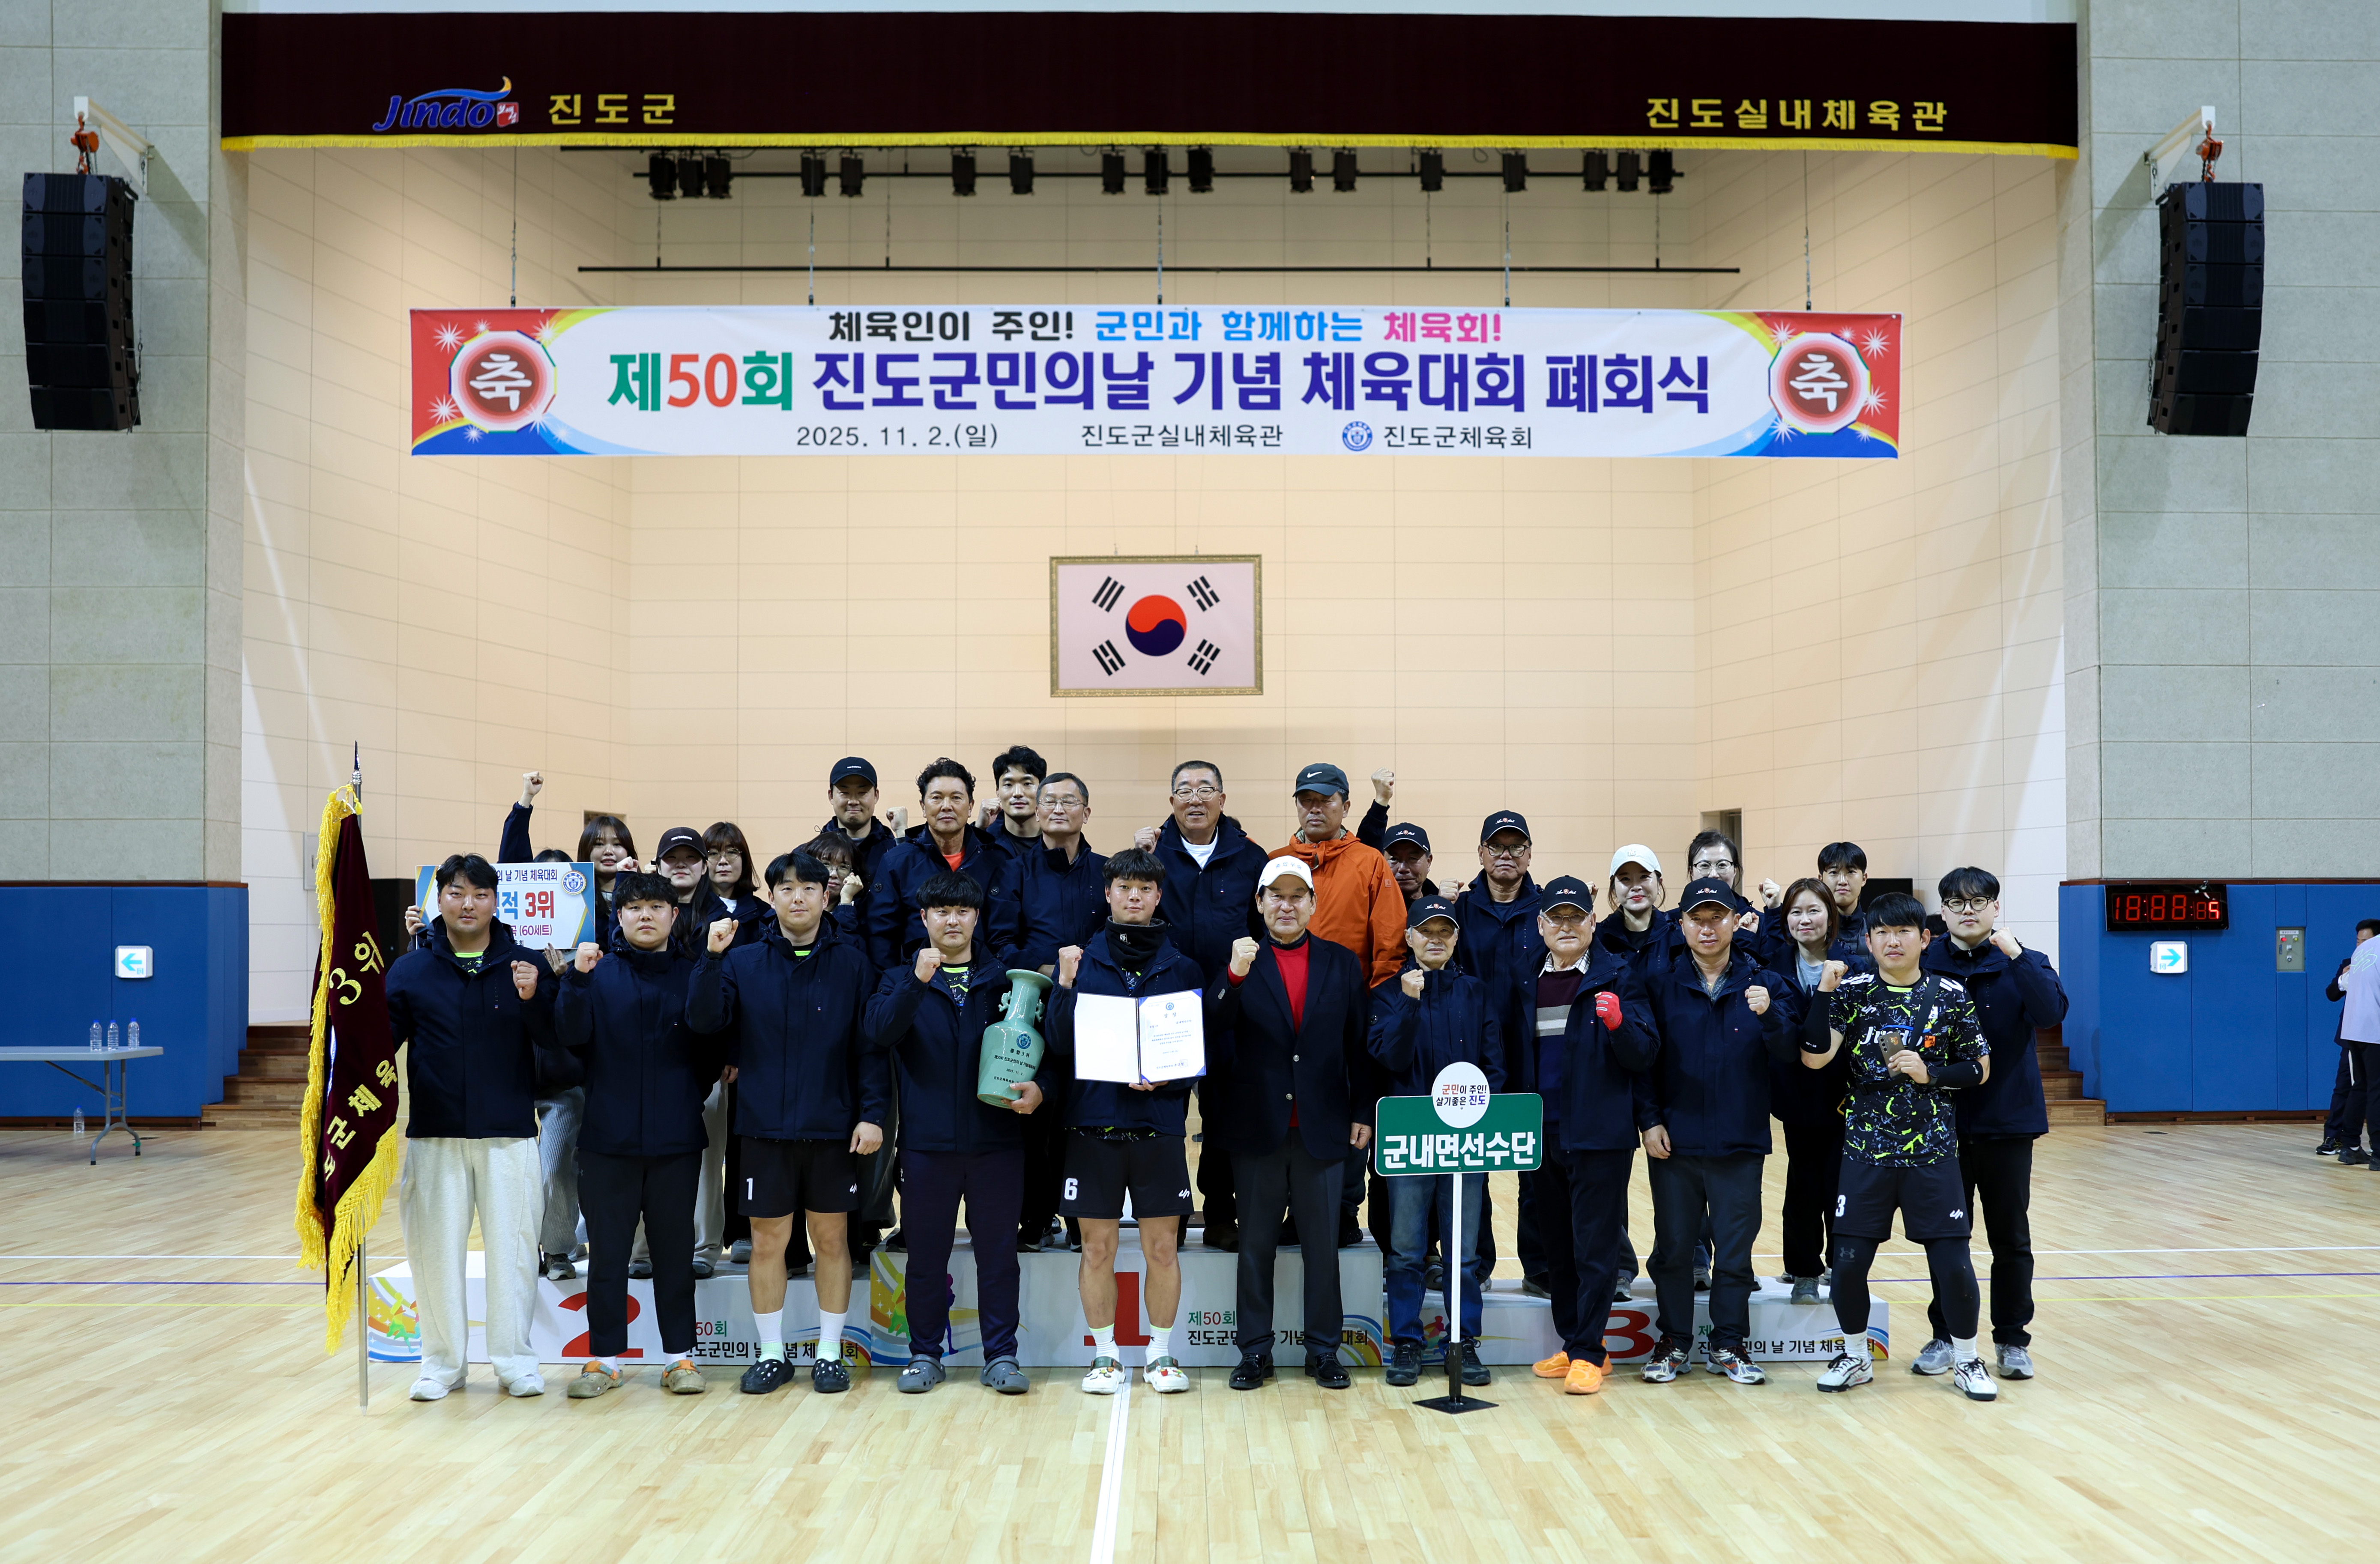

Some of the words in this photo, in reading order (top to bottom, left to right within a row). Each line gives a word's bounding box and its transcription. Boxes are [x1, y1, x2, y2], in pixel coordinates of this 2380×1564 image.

[373, 94, 495, 131] Jindo
[549, 94, 675, 125] 진도군
[1646, 98, 1947, 131] 진도실내체육관
[829, 311, 969, 342] 체육인이
[992, 311, 1073, 341] 주인!
[1095, 310, 1202, 341] 군민과
[1221, 310, 1363, 342] 함께하는
[1384, 312, 1501, 343] 체육회!
[469, 353, 532, 412] 축
[607, 350, 792, 412] 제50회
[813, 352, 1154, 410] 진도군민의날
[1174, 352, 1281, 410] 기념
[1302, 352, 1525, 412] 체육대회
[1546, 354, 1709, 414] 폐회식
[1789, 353, 1848, 412] 축
[797, 427, 868, 447] 2025.
[881, 427, 917, 447] 11.
[928, 424, 998, 448] 2.(일)
[1082, 425, 1283, 447] 진도군실내체육관
[1384, 426, 1531, 449] 진도군체육회
[505, 870, 512, 881] 날
[514, 869, 527, 881] 기념
[530, 869, 557, 881] 체육대회
[525, 890, 554, 919] 3위
[520, 924, 552, 937] (60세트)
[329, 931, 385, 1005] 3위
[1004, 1057, 1020, 1065] 진도군민의
[1442, 1084, 1467, 1095] 군민이
[1469, 1084, 1487, 1094] 주인!
[1436, 1096, 1466, 1107] 살기좋은
[1468, 1095, 1486, 1106] 진도
[1383, 1131, 1536, 1169] 군내면선수단
[746, 1178, 753, 1200] 1
[1064, 1178, 1078, 1200] 6
[695, 1320, 727, 1337] 50회
[1188, 1310, 1235, 1326] 제50회
[1188, 1330, 1238, 1346] 진도군민
[1341, 1330, 1368, 1346] 대회
[1771, 1340, 1784, 1354] 날
[1789, 1340, 1815, 1354] 기념
[1819, 1339, 1875, 1353] 체육회
[785, 1342, 798, 1359] 념
[802, 1342, 858, 1359] 체회
